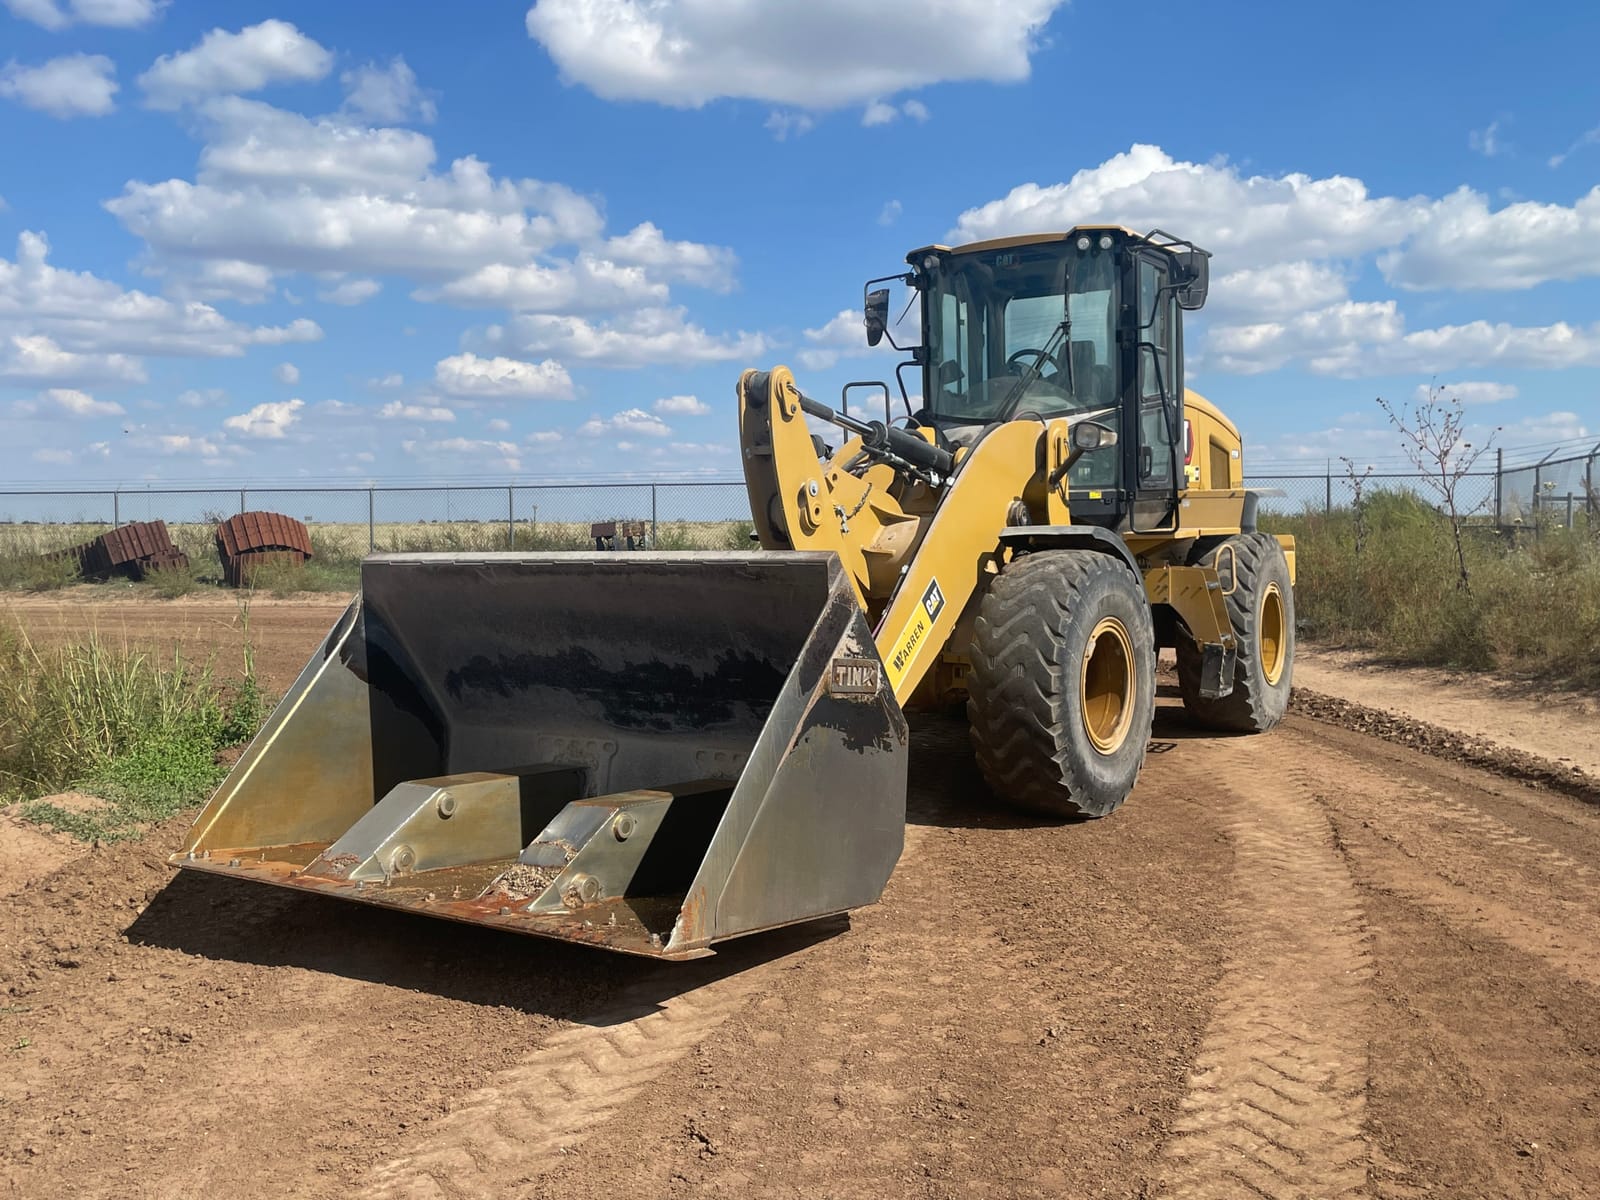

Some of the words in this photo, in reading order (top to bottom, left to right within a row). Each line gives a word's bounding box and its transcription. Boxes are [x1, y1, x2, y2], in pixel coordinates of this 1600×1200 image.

[925, 586, 941, 616] CAT
[892, 620, 925, 672] WARREN
[836, 664, 875, 687] TINK
